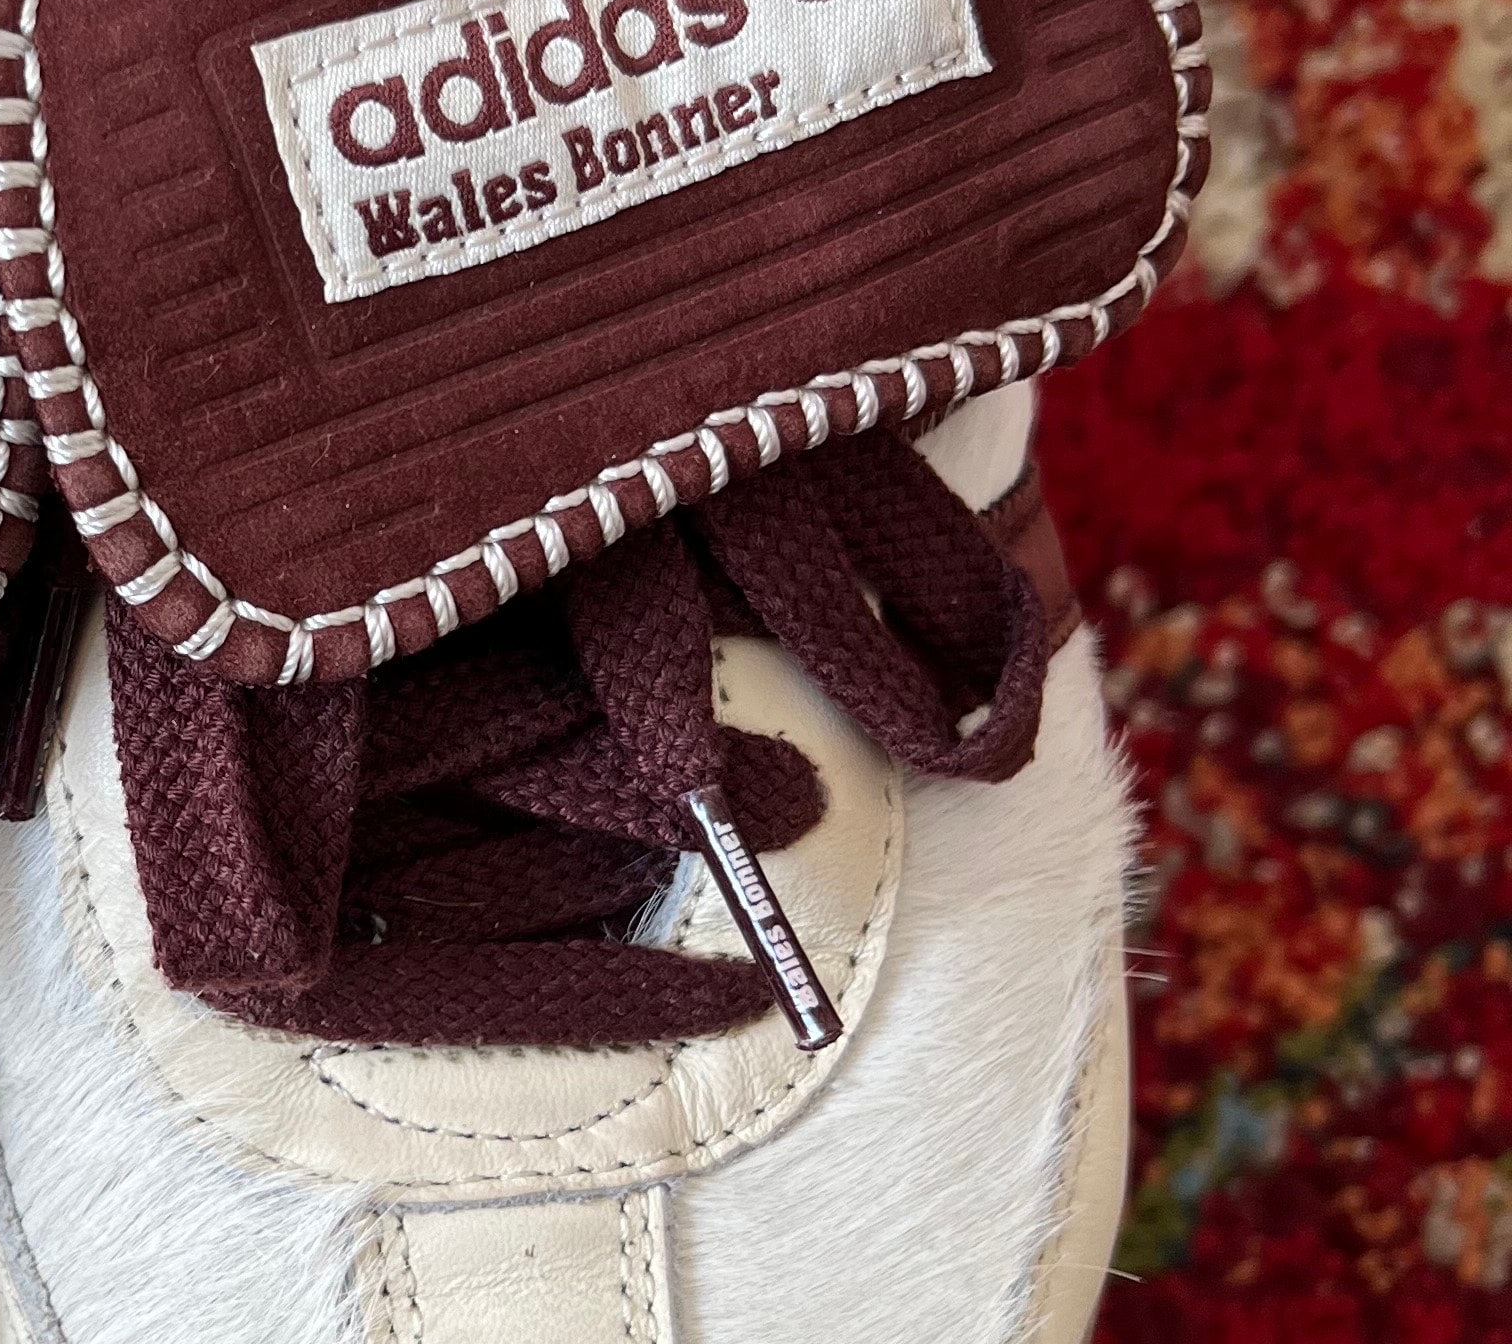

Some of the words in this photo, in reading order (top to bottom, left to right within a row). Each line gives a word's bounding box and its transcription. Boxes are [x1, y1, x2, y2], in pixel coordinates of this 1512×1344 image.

[354, 162, 558, 257] Wales
[561, 68, 781, 193] Bonner
[712, 820, 775, 921] Bonner
